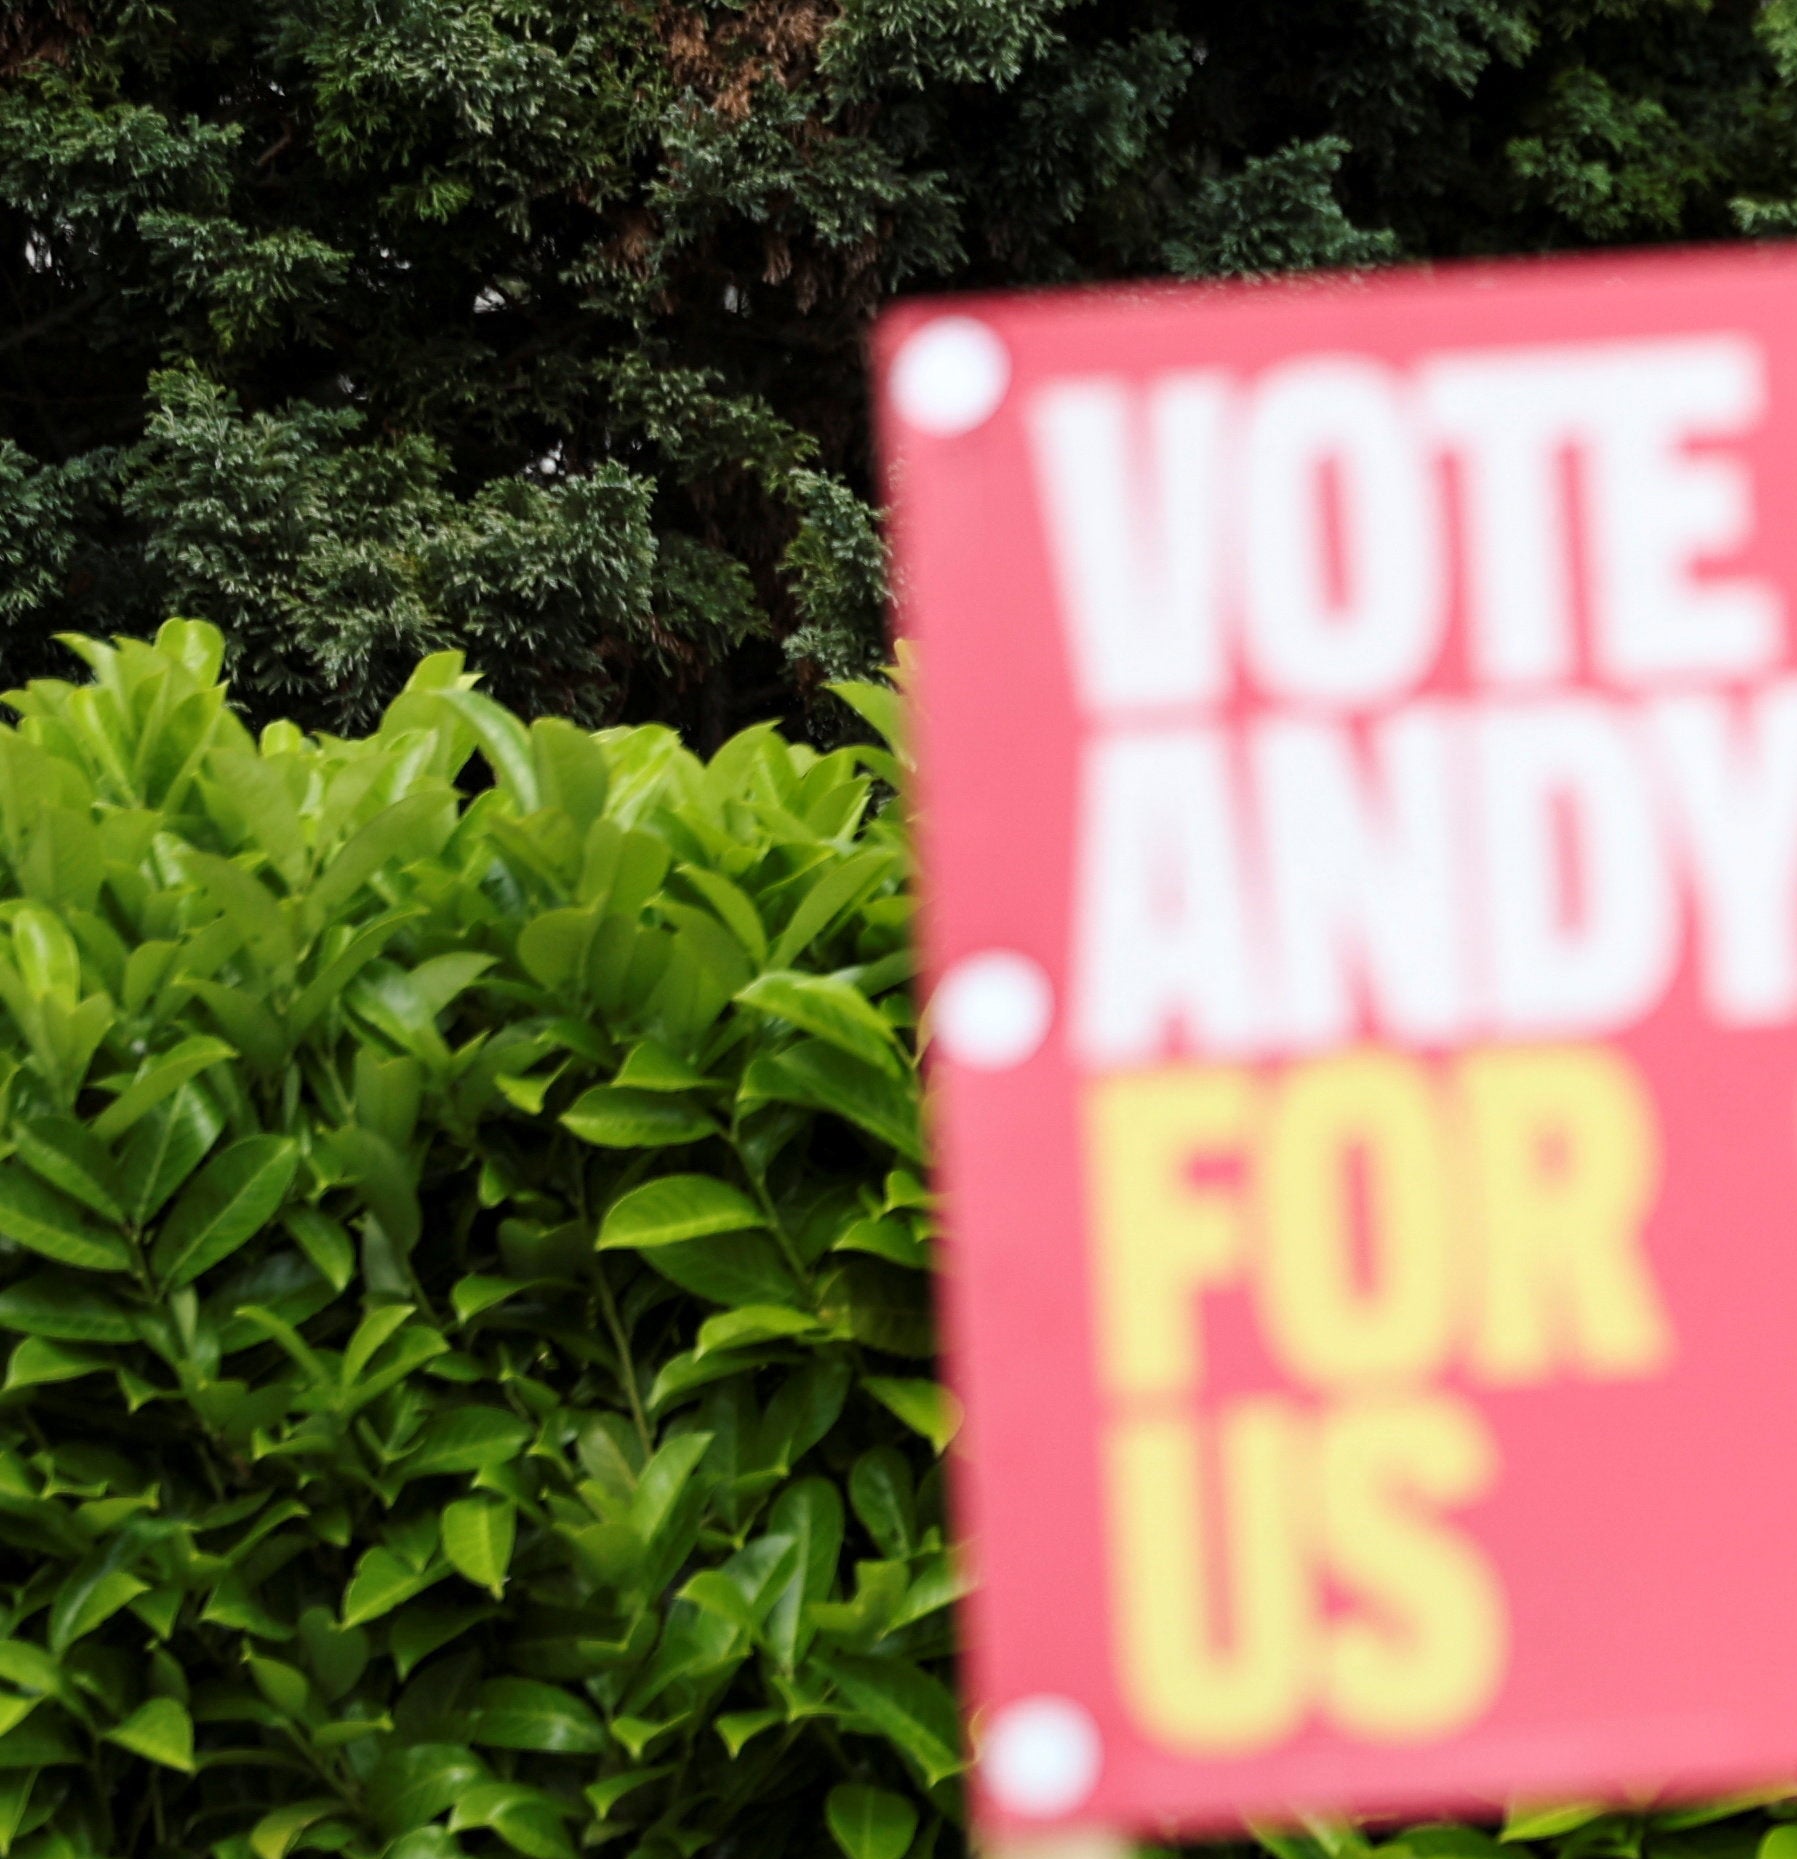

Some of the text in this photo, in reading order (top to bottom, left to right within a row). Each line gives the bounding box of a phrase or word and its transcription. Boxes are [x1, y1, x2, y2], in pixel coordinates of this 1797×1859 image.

[1034, 338, 1784, 714] VOTE
[1085, 1044, 1672, 1398] FOR
[1112, 1393, 1504, 1753] US
